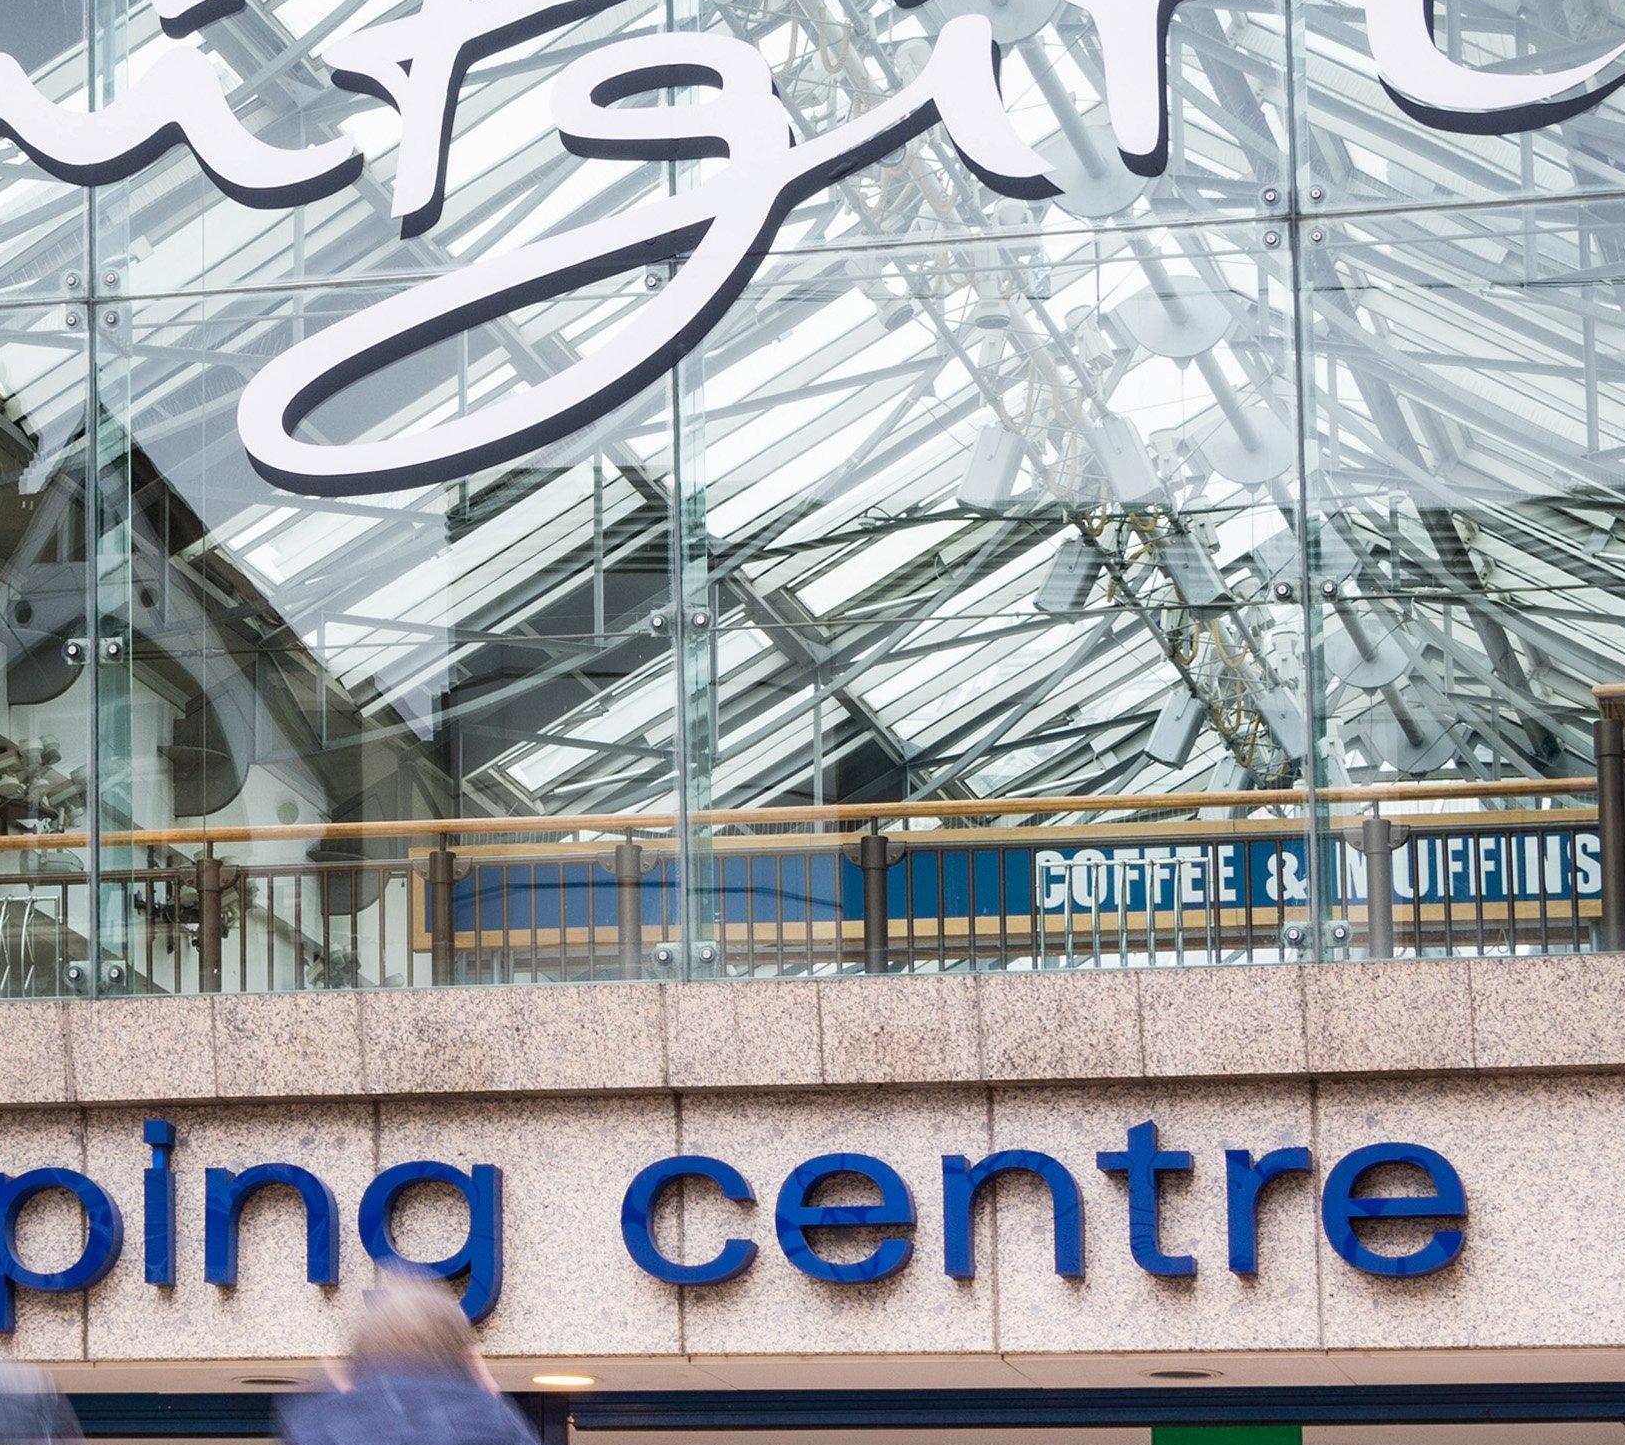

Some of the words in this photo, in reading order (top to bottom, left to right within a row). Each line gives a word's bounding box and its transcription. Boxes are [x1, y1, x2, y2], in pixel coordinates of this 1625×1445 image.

[1035, 844, 1237, 908] COFFEE
[1265, 850, 1310, 901] &
[620, 1119, 1469, 1287] centre
